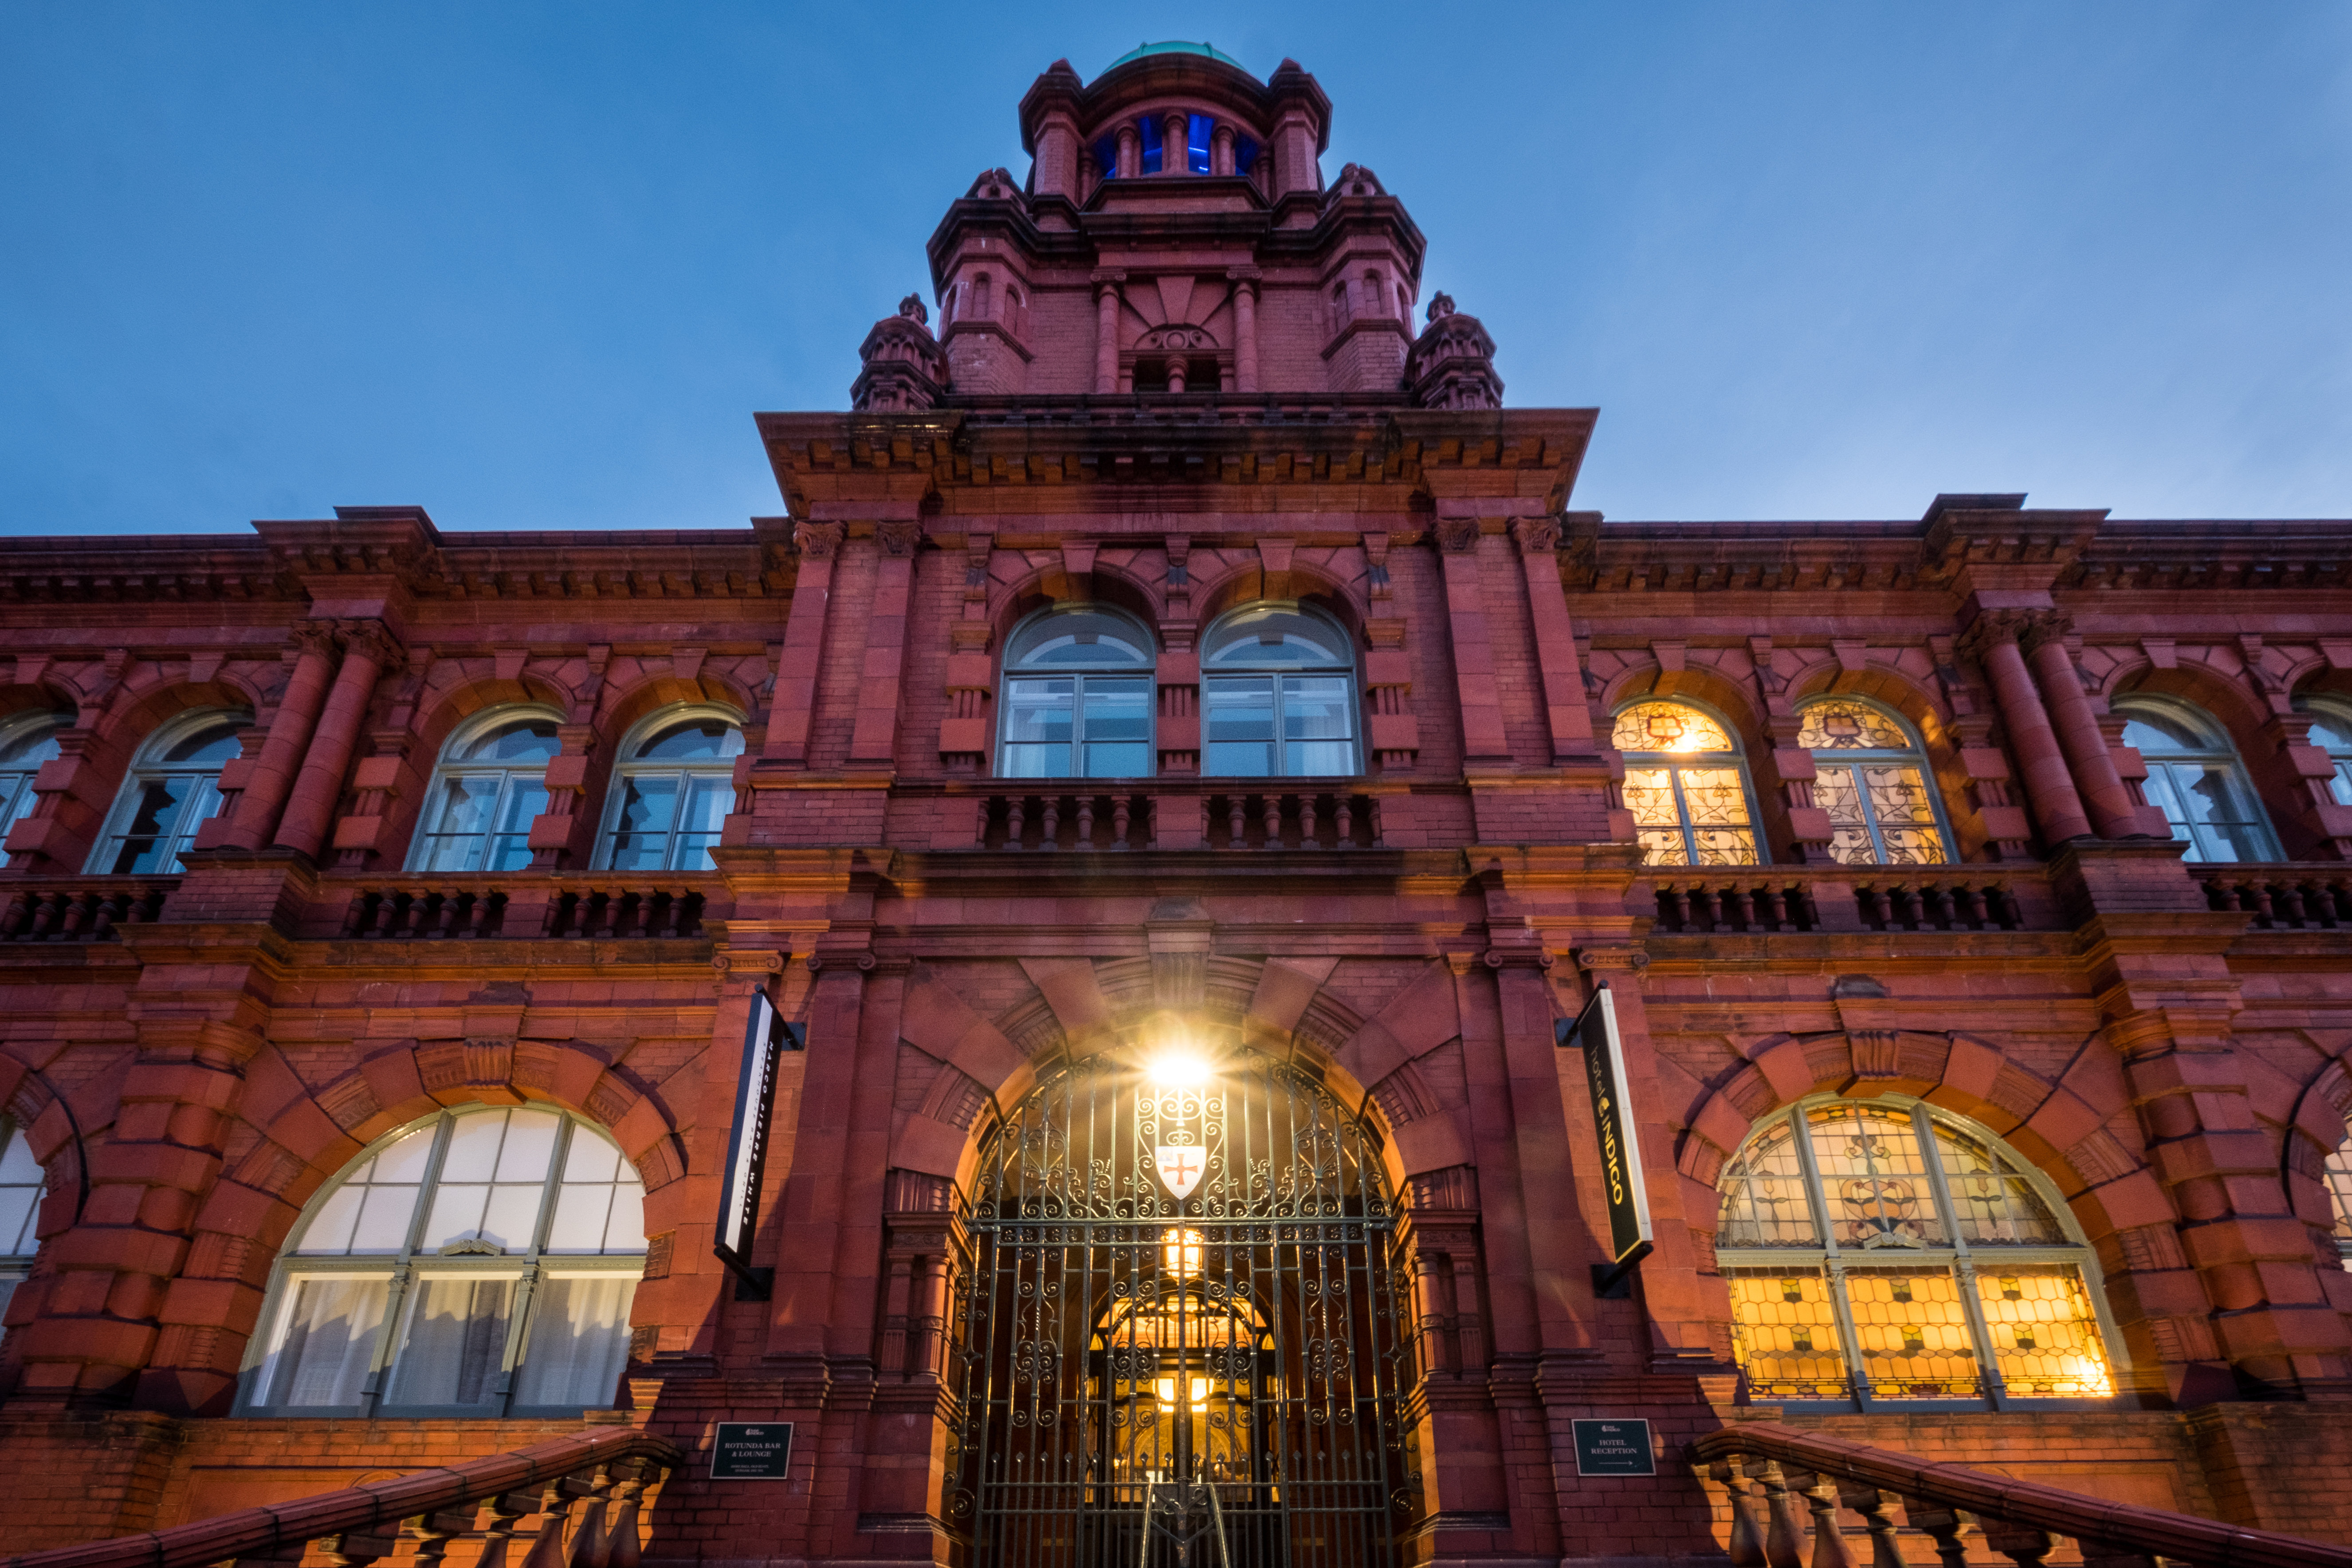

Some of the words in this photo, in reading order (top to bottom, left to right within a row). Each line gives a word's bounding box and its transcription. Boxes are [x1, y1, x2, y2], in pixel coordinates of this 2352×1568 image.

[763, 1041, 773, 1093] MARCO
[753, 1103, 765, 1161] PIERRE
[1590, 1045, 1606, 1098] hotel
[1602, 1114, 1622, 1205] INDIGO
[743, 1172, 754, 1225] WHITE
